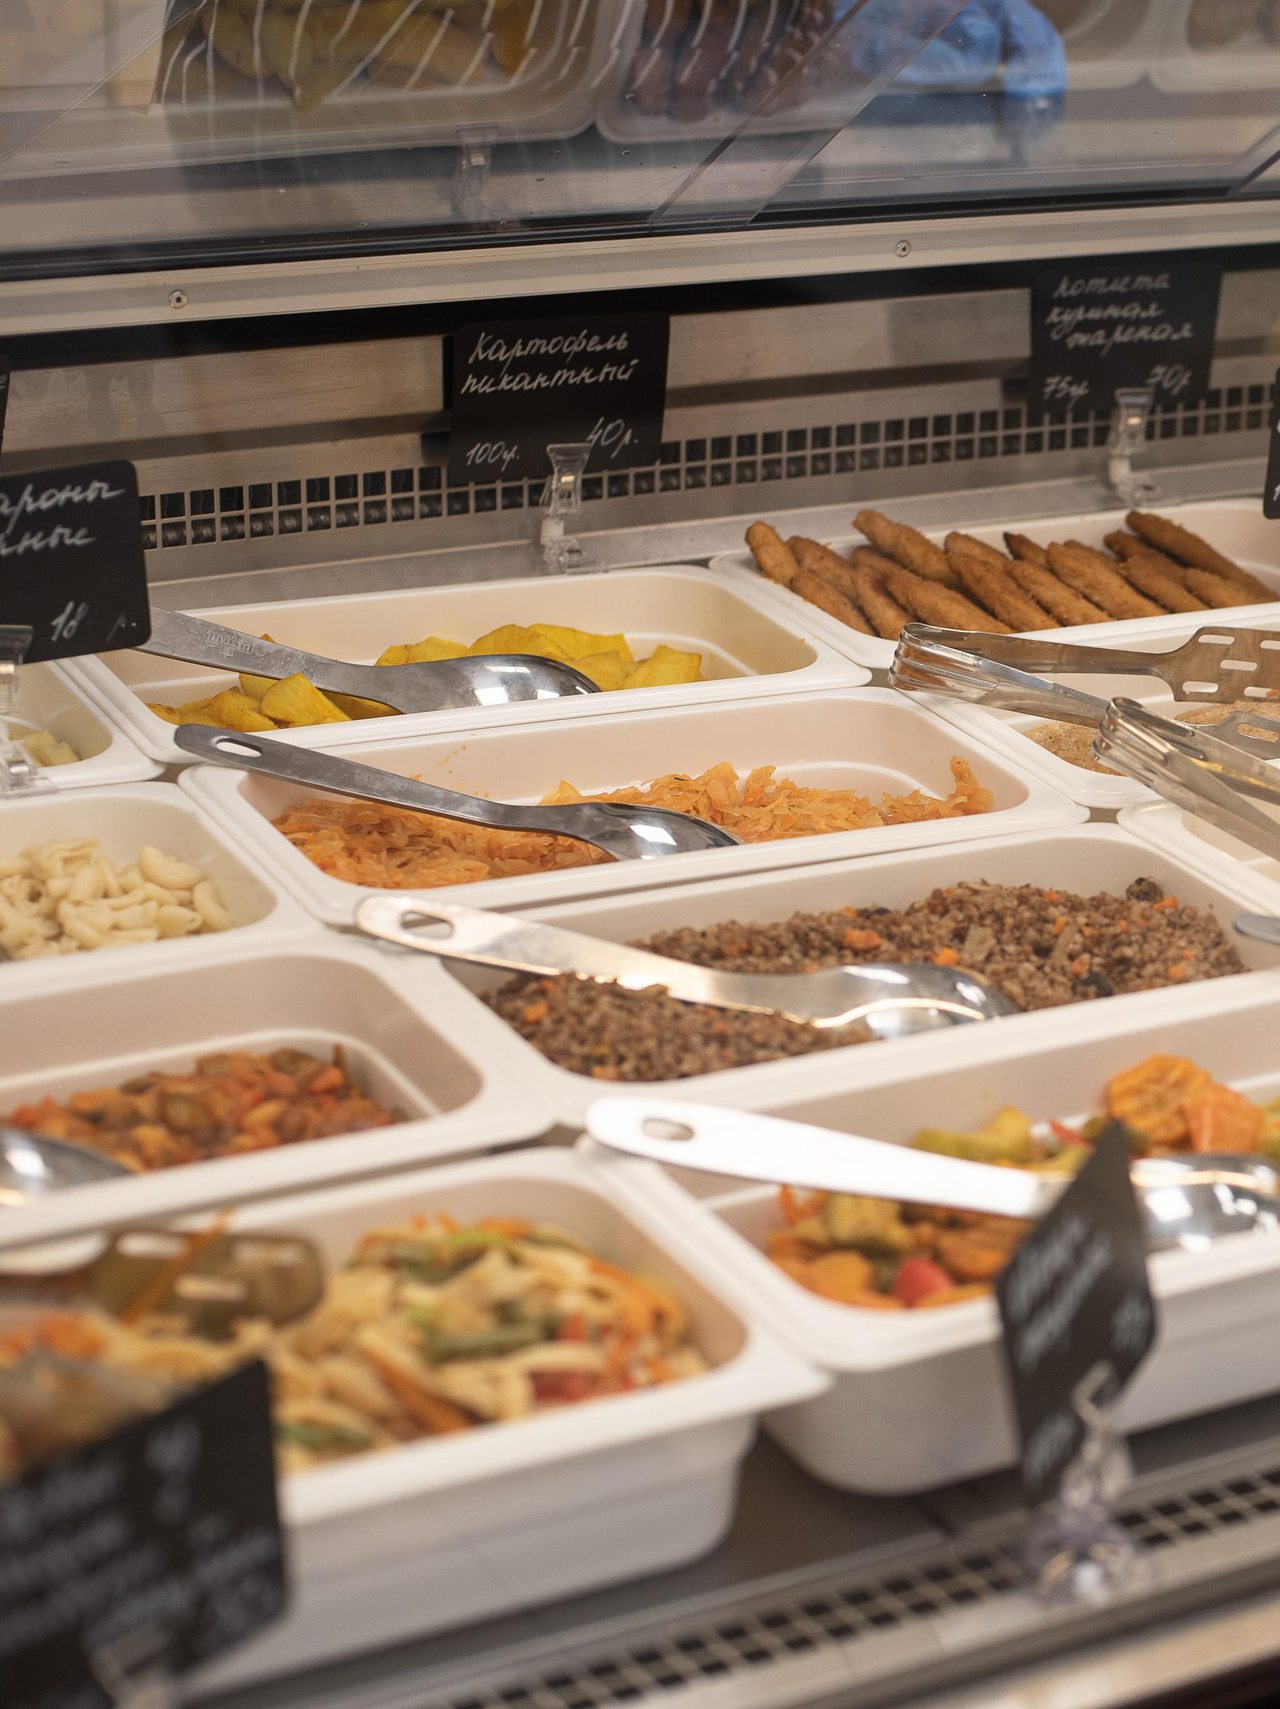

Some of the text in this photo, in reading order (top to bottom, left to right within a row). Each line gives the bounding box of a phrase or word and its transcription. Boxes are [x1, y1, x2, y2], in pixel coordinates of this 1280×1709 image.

[468, 329, 629, 376] Картофель
[460, 359, 639, 394] пикантный
[206, 631, 256, 654] LUXSTAHL
